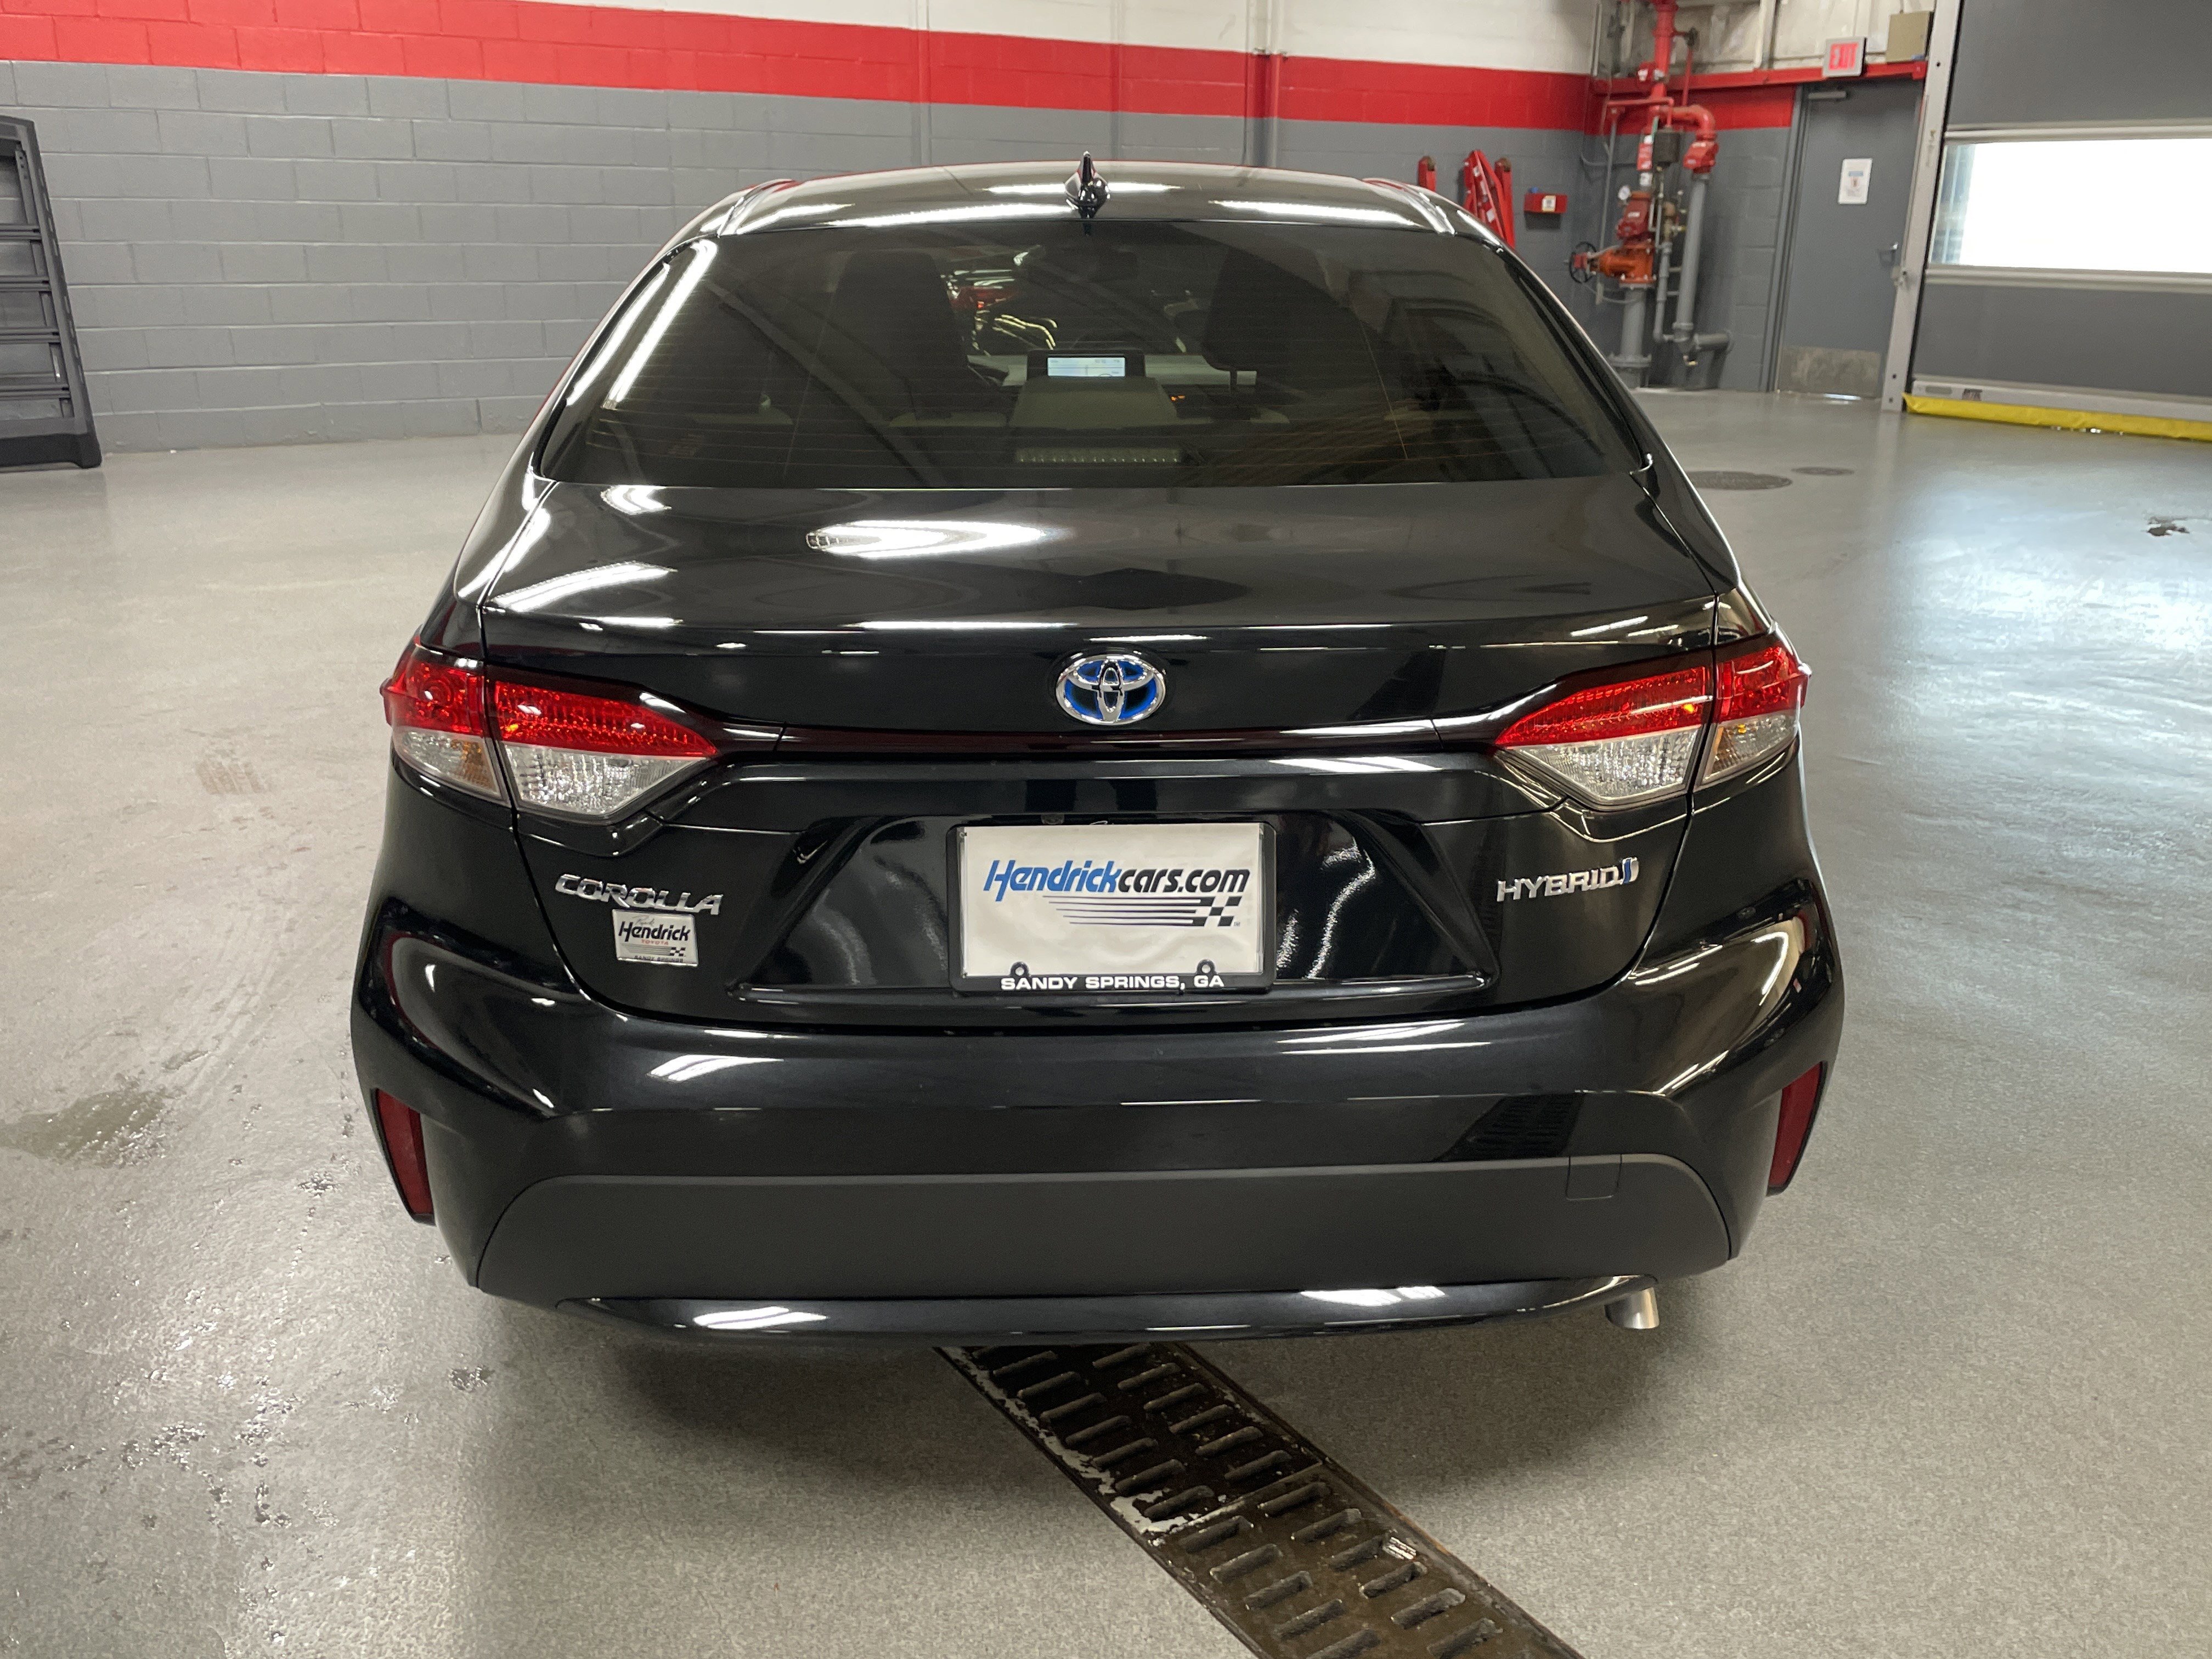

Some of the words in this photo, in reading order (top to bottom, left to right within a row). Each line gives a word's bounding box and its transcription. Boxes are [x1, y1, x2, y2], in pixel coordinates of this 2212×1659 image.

[1829, 42, 1859, 70] EXIT
[555, 873, 724, 916] COROLLA
[983, 860, 1250, 902] Hendrickcars.com
[1496, 866, 1622, 902] HYBRID
[618, 921, 691, 943] Hendrick
[1001, 976, 1078, 990] SANDY
[1085, 975, 1186, 990] SPRINGS,
[1193, 974, 1225, 988] GA
